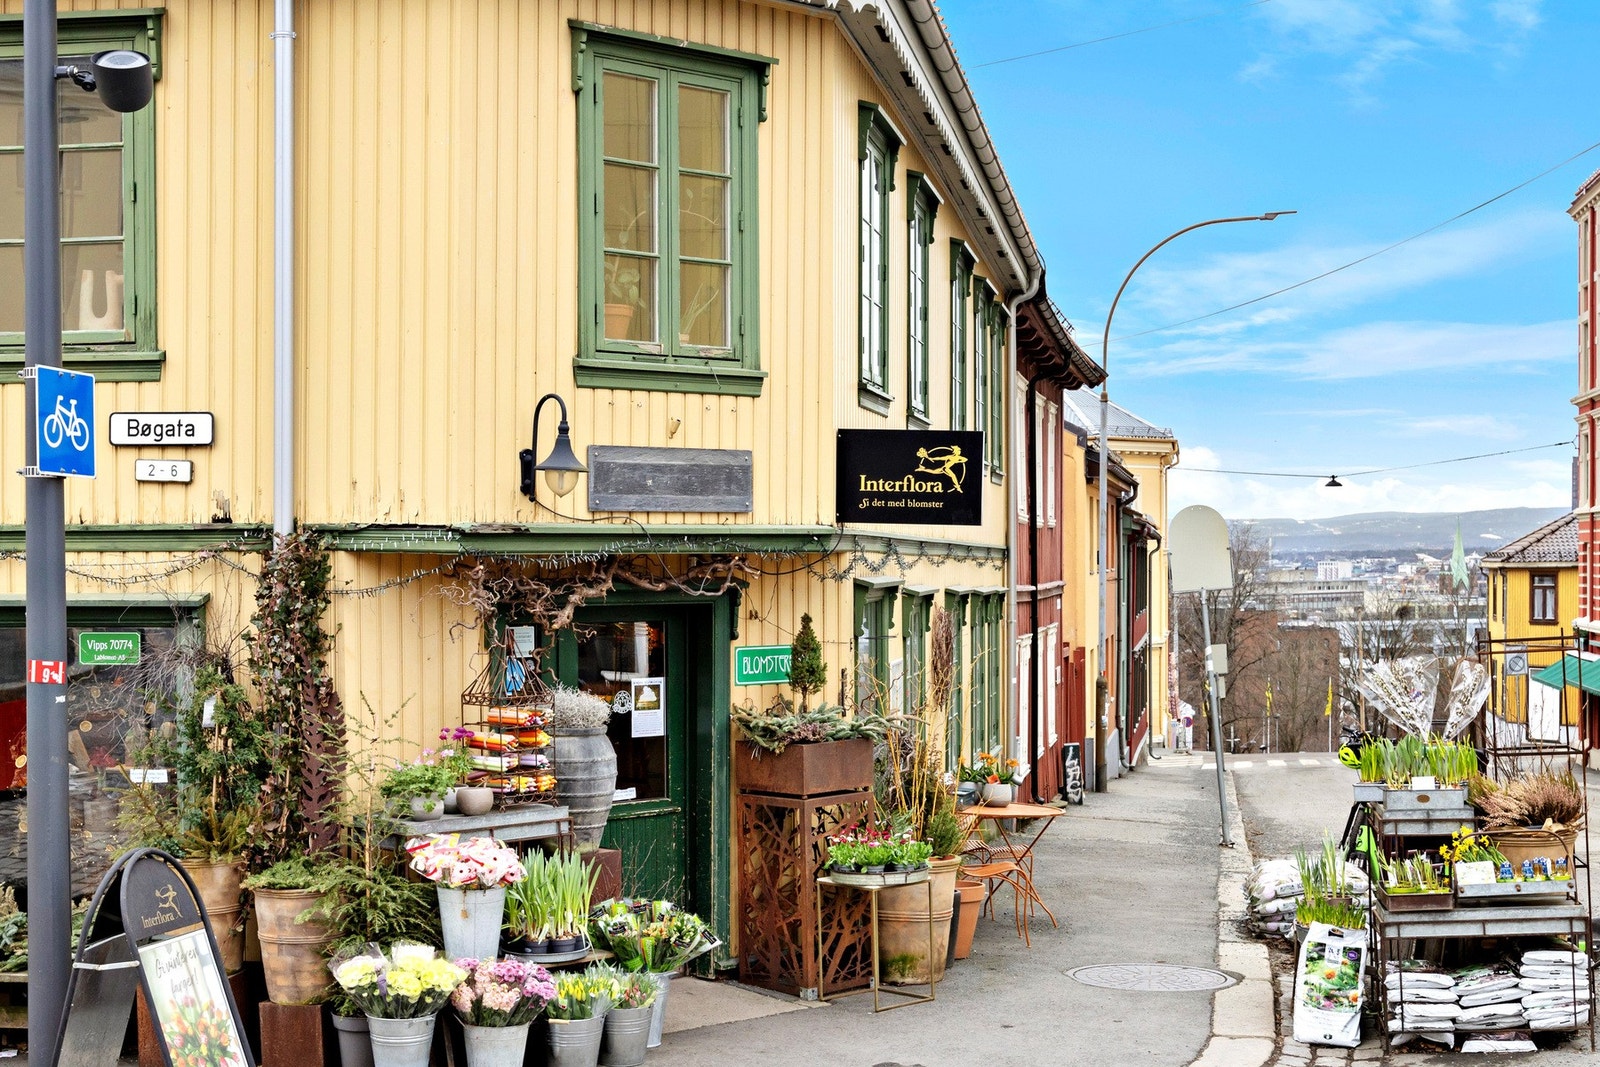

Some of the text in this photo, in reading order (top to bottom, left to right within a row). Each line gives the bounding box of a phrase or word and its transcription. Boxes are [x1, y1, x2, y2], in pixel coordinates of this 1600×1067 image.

[127, 418, 195, 442] Bøgata
[148, 464, 156, 476] 2
[170, 464, 178, 477] 6
[859, 474, 944, 493] Interflora
[872, 498, 885, 508] det
[887, 498, 905, 508] med
[908, 499, 944, 509] blomster
[86, 639, 133, 652] Vipps 70774
[141, 911, 175, 929] Interflora
